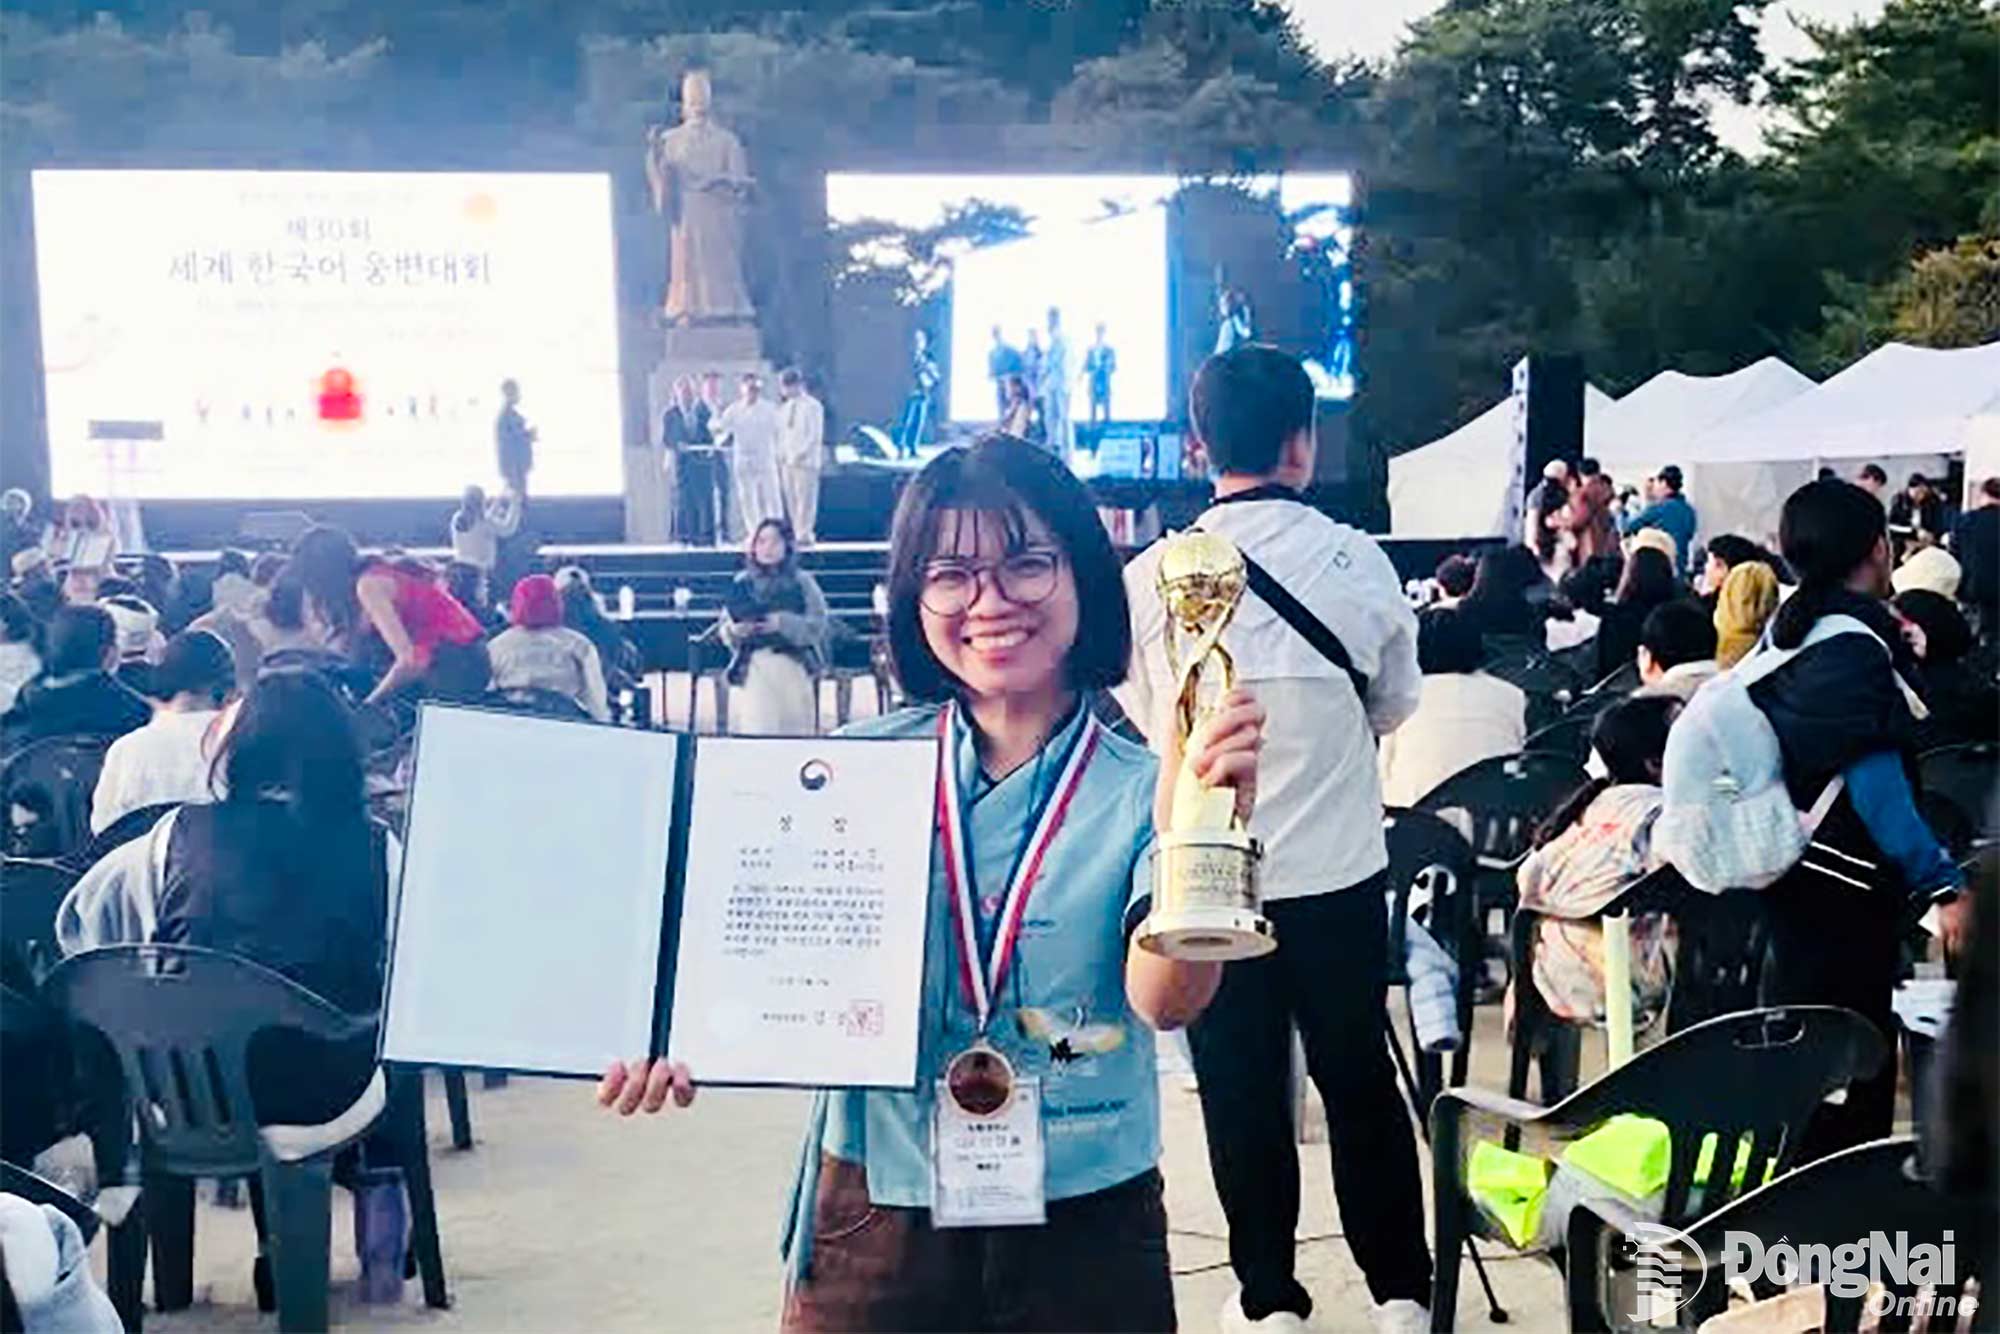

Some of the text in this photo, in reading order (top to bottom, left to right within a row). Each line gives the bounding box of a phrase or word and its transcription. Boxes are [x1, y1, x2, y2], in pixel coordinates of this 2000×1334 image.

[168, 250, 492, 287] 세계 한국어 웅변대회
